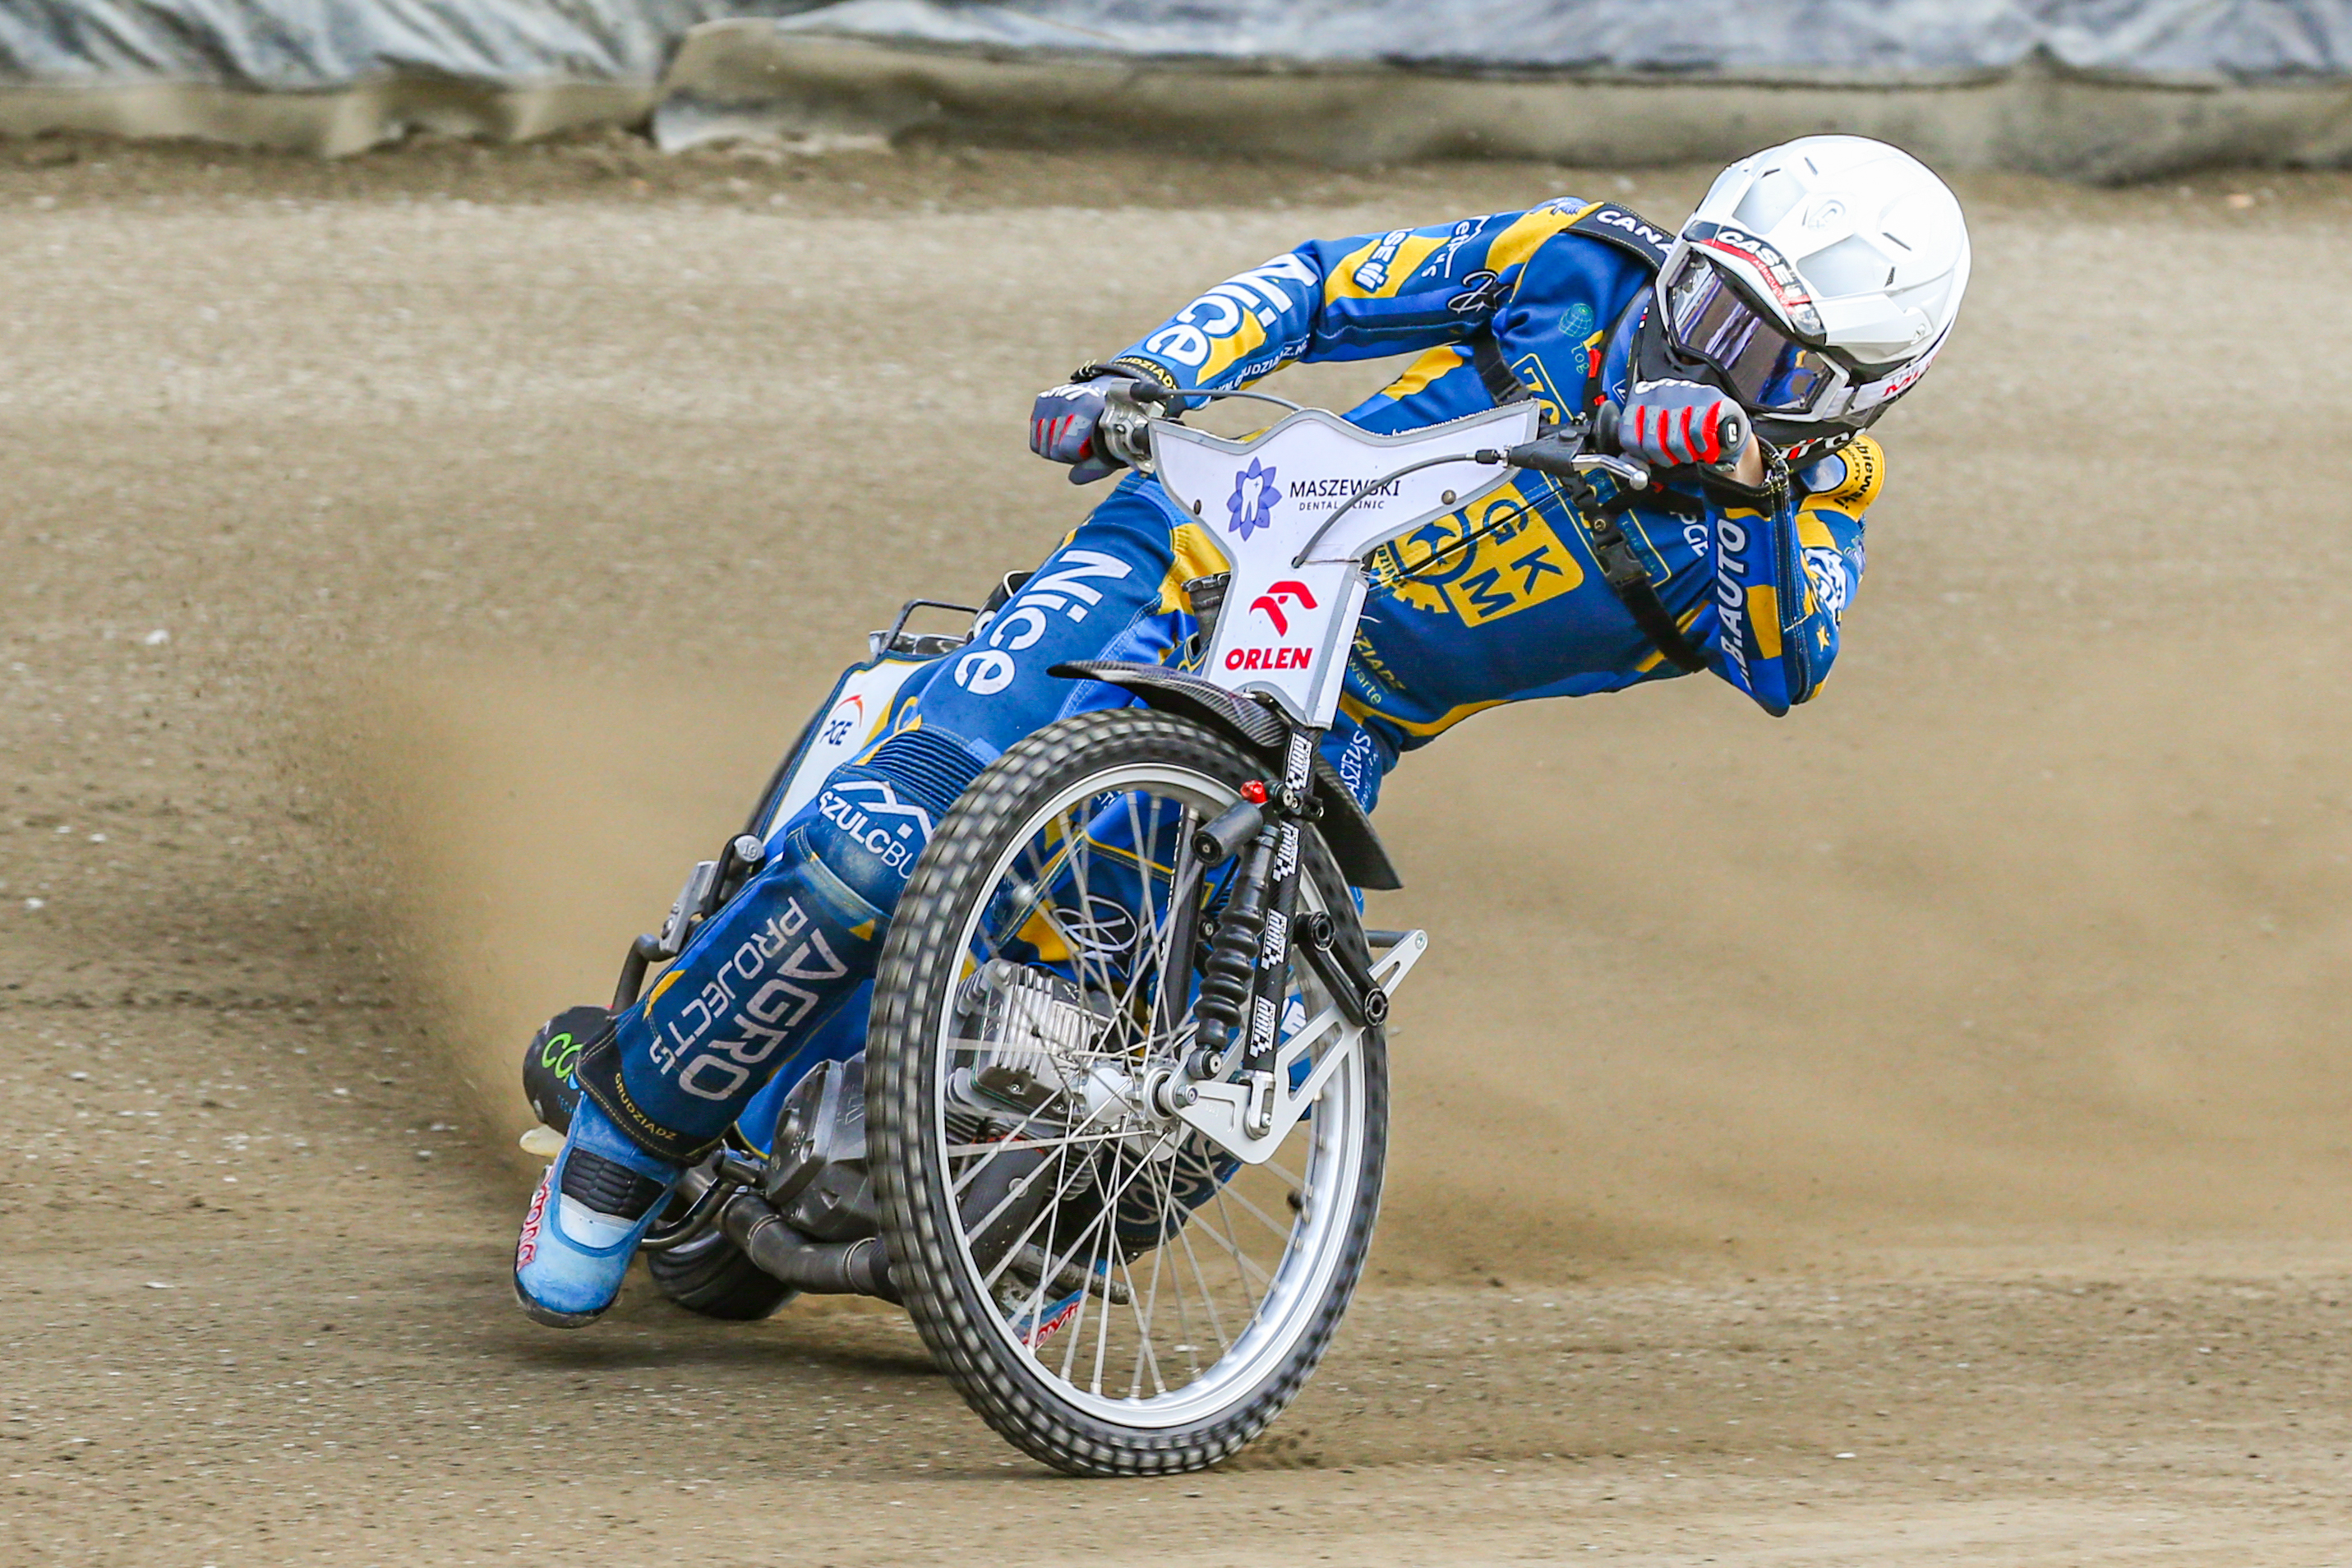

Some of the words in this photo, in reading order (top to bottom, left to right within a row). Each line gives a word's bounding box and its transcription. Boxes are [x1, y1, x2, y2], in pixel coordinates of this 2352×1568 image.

[1717, 231, 1794, 286] CASE
[1146, 252, 1318, 367] Nice
[1299, 500, 1338, 510] DENTAL
[953, 550, 1133, 695] Nice
[1225, 648, 1313, 671] ORLEN
[819, 719, 854, 746] PGE
[649, 897, 809, 1075] PROJECTS
[679, 928, 848, 1101] AGRO
[615, 1072, 677, 1141] GRUDZIADZ
